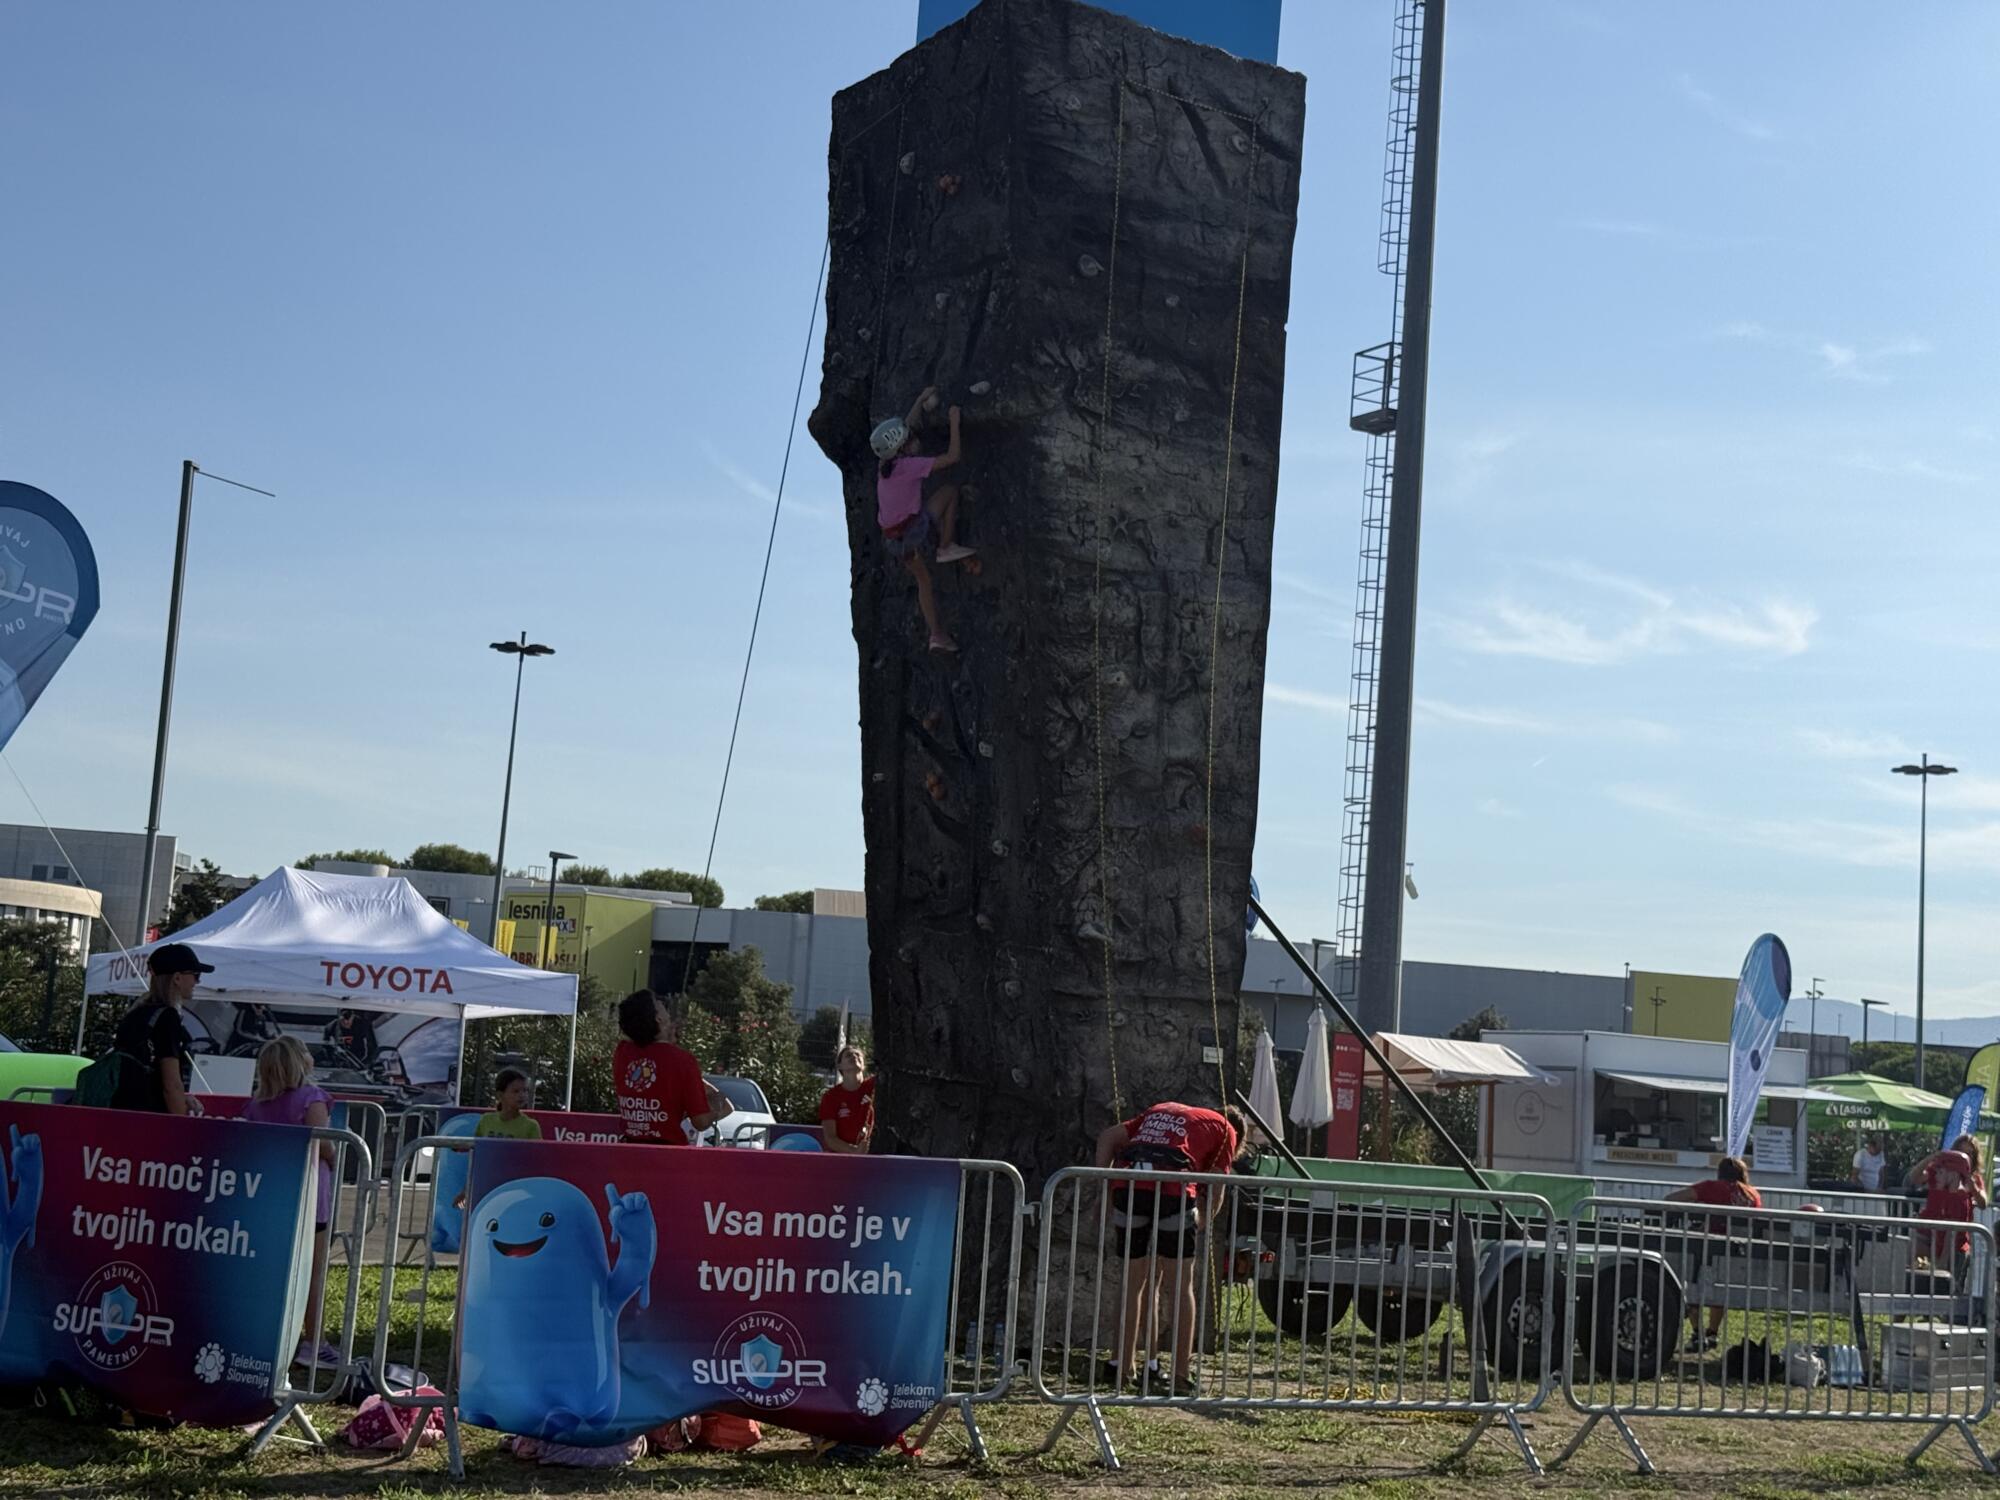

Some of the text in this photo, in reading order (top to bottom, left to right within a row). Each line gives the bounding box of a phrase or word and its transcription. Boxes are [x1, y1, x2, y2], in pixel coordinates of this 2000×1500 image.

[108, 952, 152, 983] TOYOT
[320, 960, 454, 994] TOYOTA
[620, 1109, 669, 1122] LIMBING
[554, 1127, 624, 1143] Vsa mo
[83, 1146, 262, 1203] Vsa moč je v
[72, 1205, 256, 1258] tvojih rokah.
[703, 1201, 911, 1248] Vsa moč je v
[103, 1265, 141, 1283] UŽIVAJ
[698, 1258, 912, 1301] tvojih rokah.
[739, 1316, 784, 1333] UŽIVAJ
[83, 1339, 138, 1365] PAMETNO
[230, 1352, 272, 1372] Telekom
[226, 1367, 269, 1388] Slovenije
[736, 1387, 796, 1407] PAMETNO
[893, 1383, 935, 1396] Telekom
[890, 1397, 935, 1412] Slovenije
